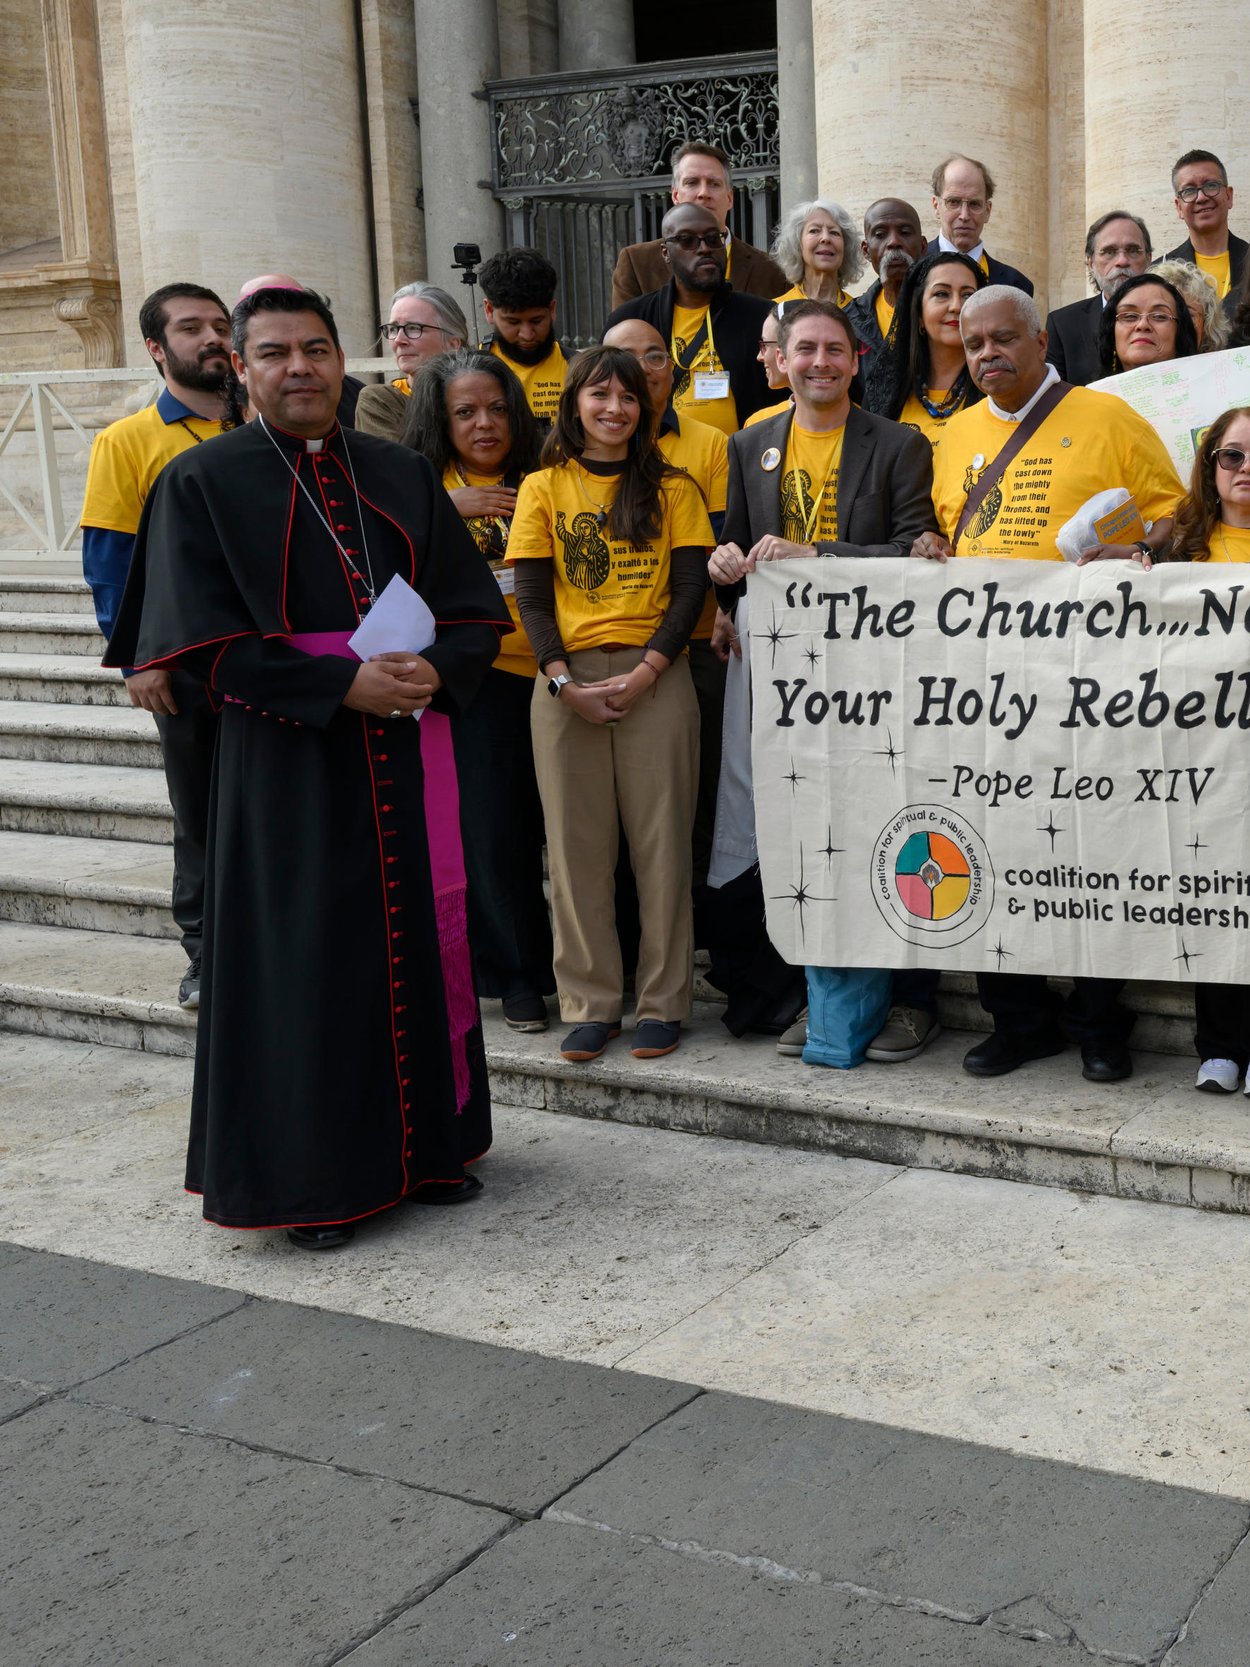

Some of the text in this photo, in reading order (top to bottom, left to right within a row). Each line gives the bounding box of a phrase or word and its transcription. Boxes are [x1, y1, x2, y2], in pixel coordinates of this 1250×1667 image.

[1039, 457, 1052, 465] has
[1013, 480, 1051, 491] the mighty
[1012, 493, 1046, 502] from their
[1003, 505, 1050, 514] thrones, and
[1000, 517, 1048, 527] has lifted up
[999, 528, 1011, 536] the
[613, 546, 627, 554] sus
[611, 561, 615, 569] y
[617, 558, 641, 568] exaltó
[772, 677, 893, 729] Your
[913, 671, 1039, 741] Holy
[1050, 766, 1114, 802] Leo
[1133, 766, 1216, 806] XIV
[877, 809, 982, 906] coalition for spiritual & public leadership
[1004, 866, 1120, 892] coalition
[1128, 867, 1172, 893] for
[1007, 896, 1026, 915] &
[1033, 898, 1114, 922] public
